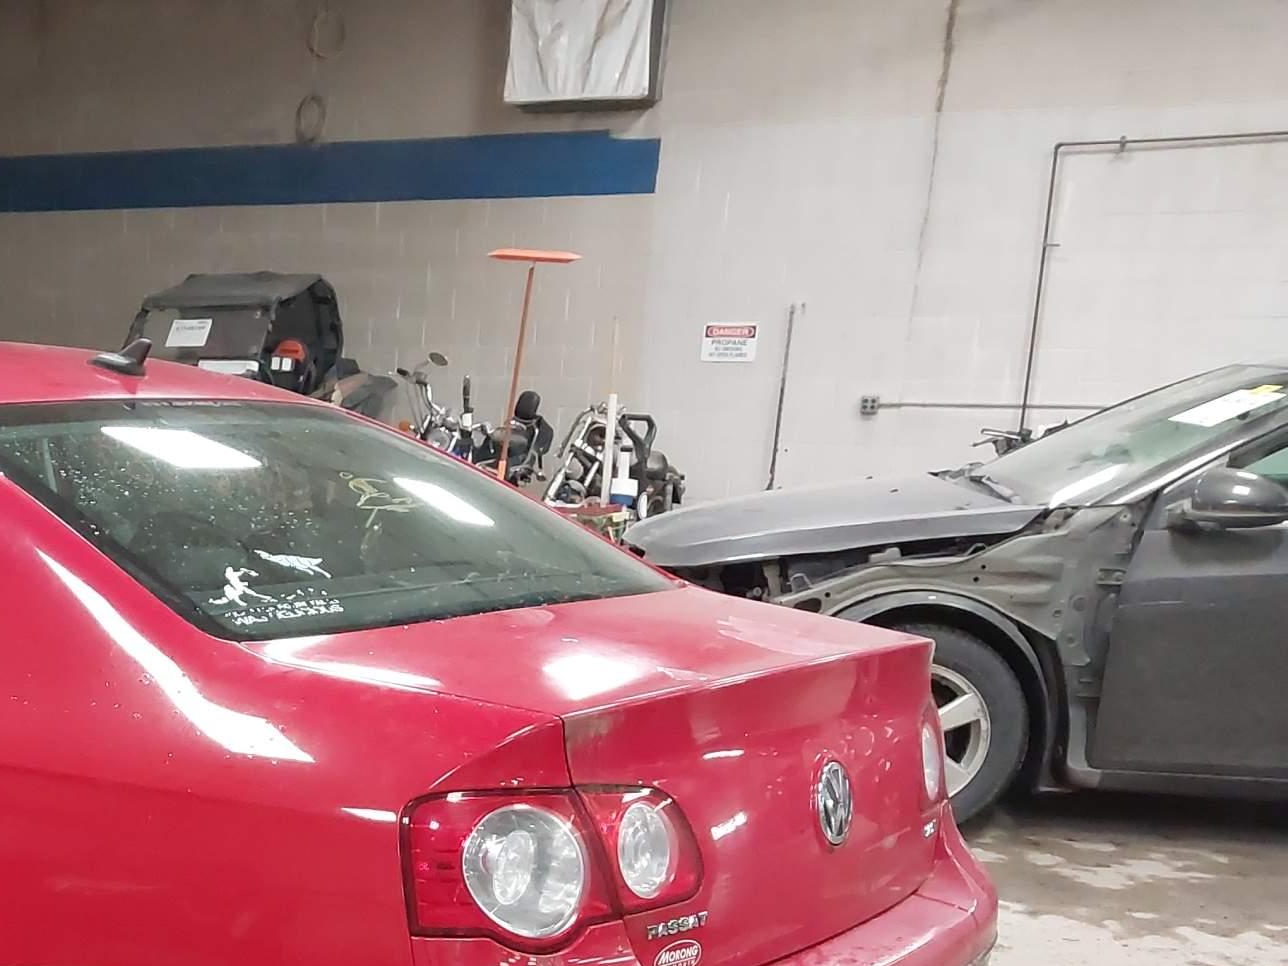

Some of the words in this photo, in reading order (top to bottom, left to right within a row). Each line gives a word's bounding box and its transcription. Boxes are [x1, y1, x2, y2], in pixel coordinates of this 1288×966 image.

[712, 327, 749, 337] DANGER
[647, 911, 708, 940] PASSAT
[658, 945, 699, 965] MORONG
